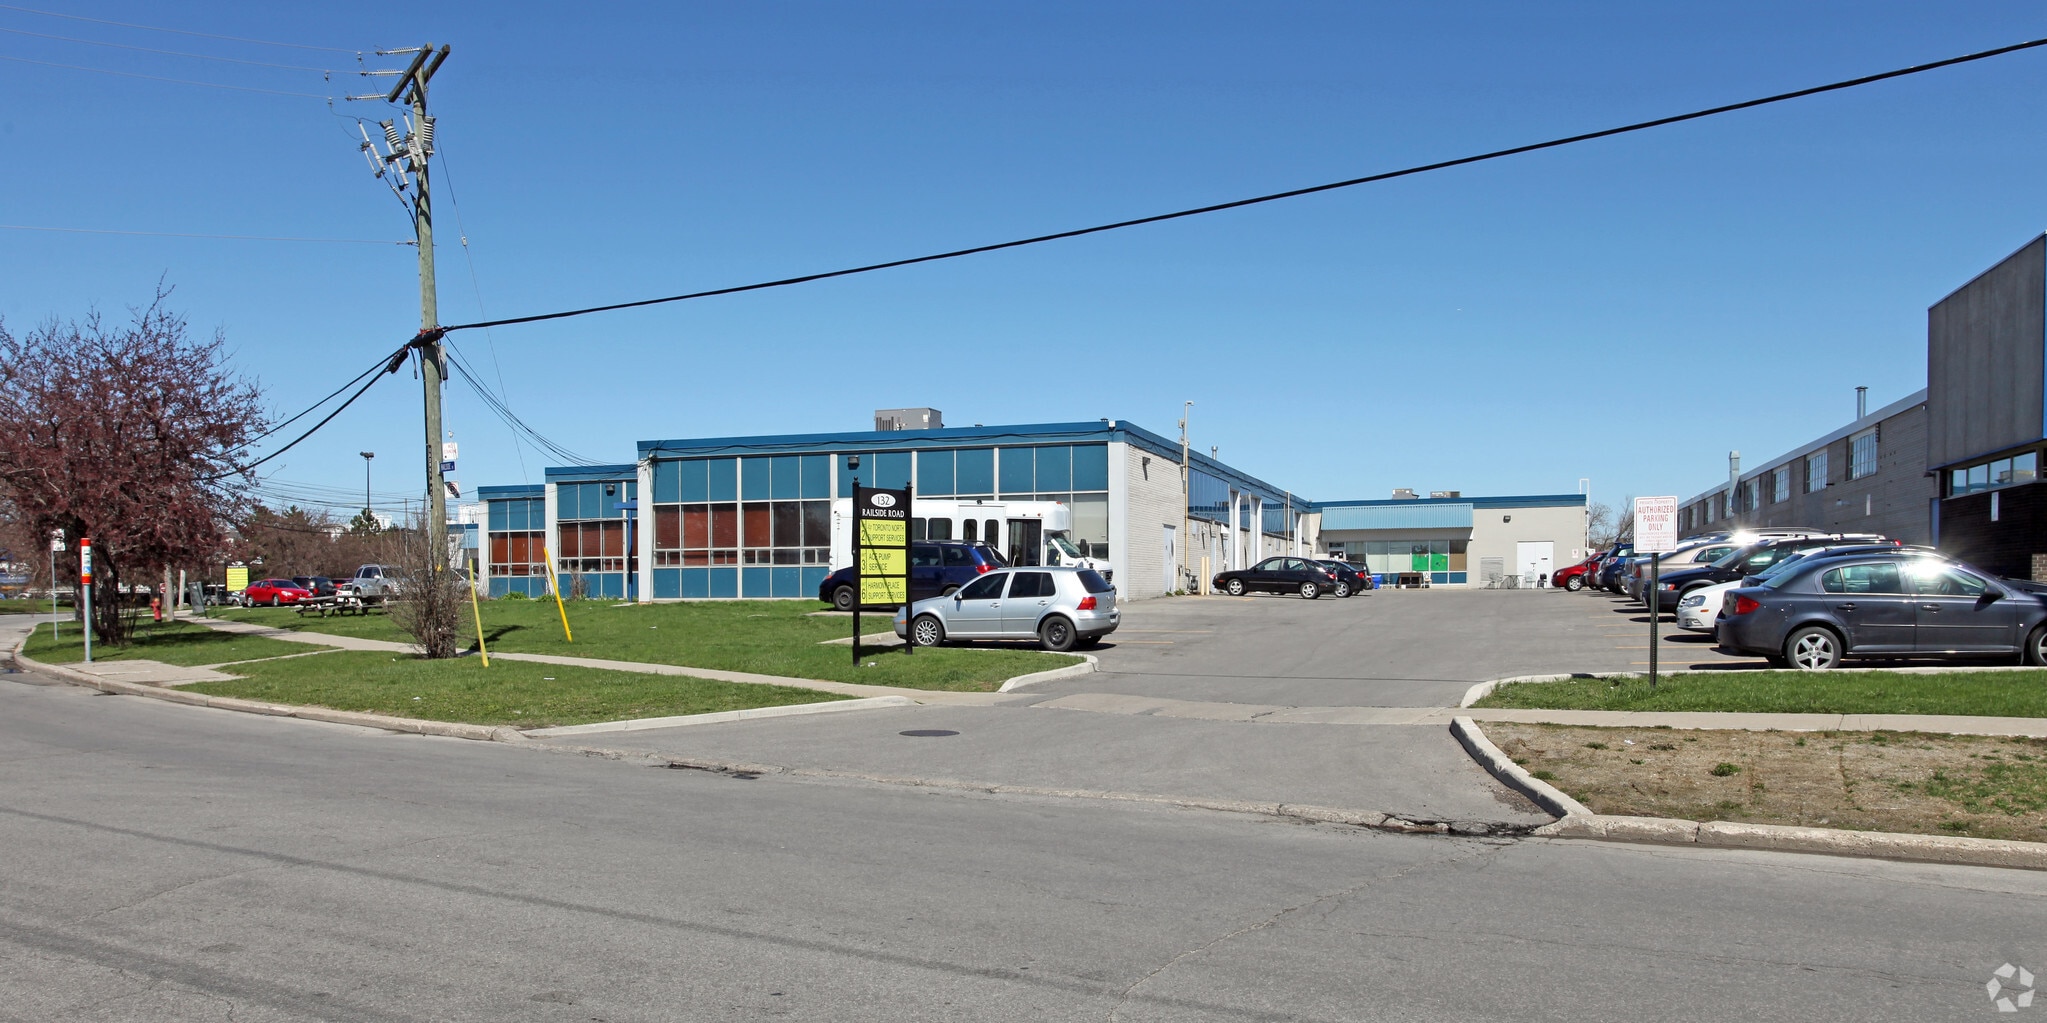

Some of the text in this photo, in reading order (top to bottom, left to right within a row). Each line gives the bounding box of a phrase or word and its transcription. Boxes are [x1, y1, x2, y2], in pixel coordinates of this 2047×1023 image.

[877, 495, 890, 506] 132
[862, 508, 905, 518] RAILSIDE ROAD
[1638, 505, 1674, 514] AUTHORIZED
[1643, 514, 1669, 522] PARKING
[872, 523, 891, 531] TORONTO
[891, 524, 905, 532] NORTH
[1648, 523, 1664, 531] ONLY
[861, 530, 866, 541] 2
[886, 534, 905, 542] SERVICES
[878, 552, 891, 560] PUMP
[861, 559, 866, 571] 3
[868, 563, 888, 571] SERVICE
[887, 581, 900, 589] PLACE
[861, 588, 866, 600] 6
[867, 591, 905, 600] SUPPORT SERVICES
